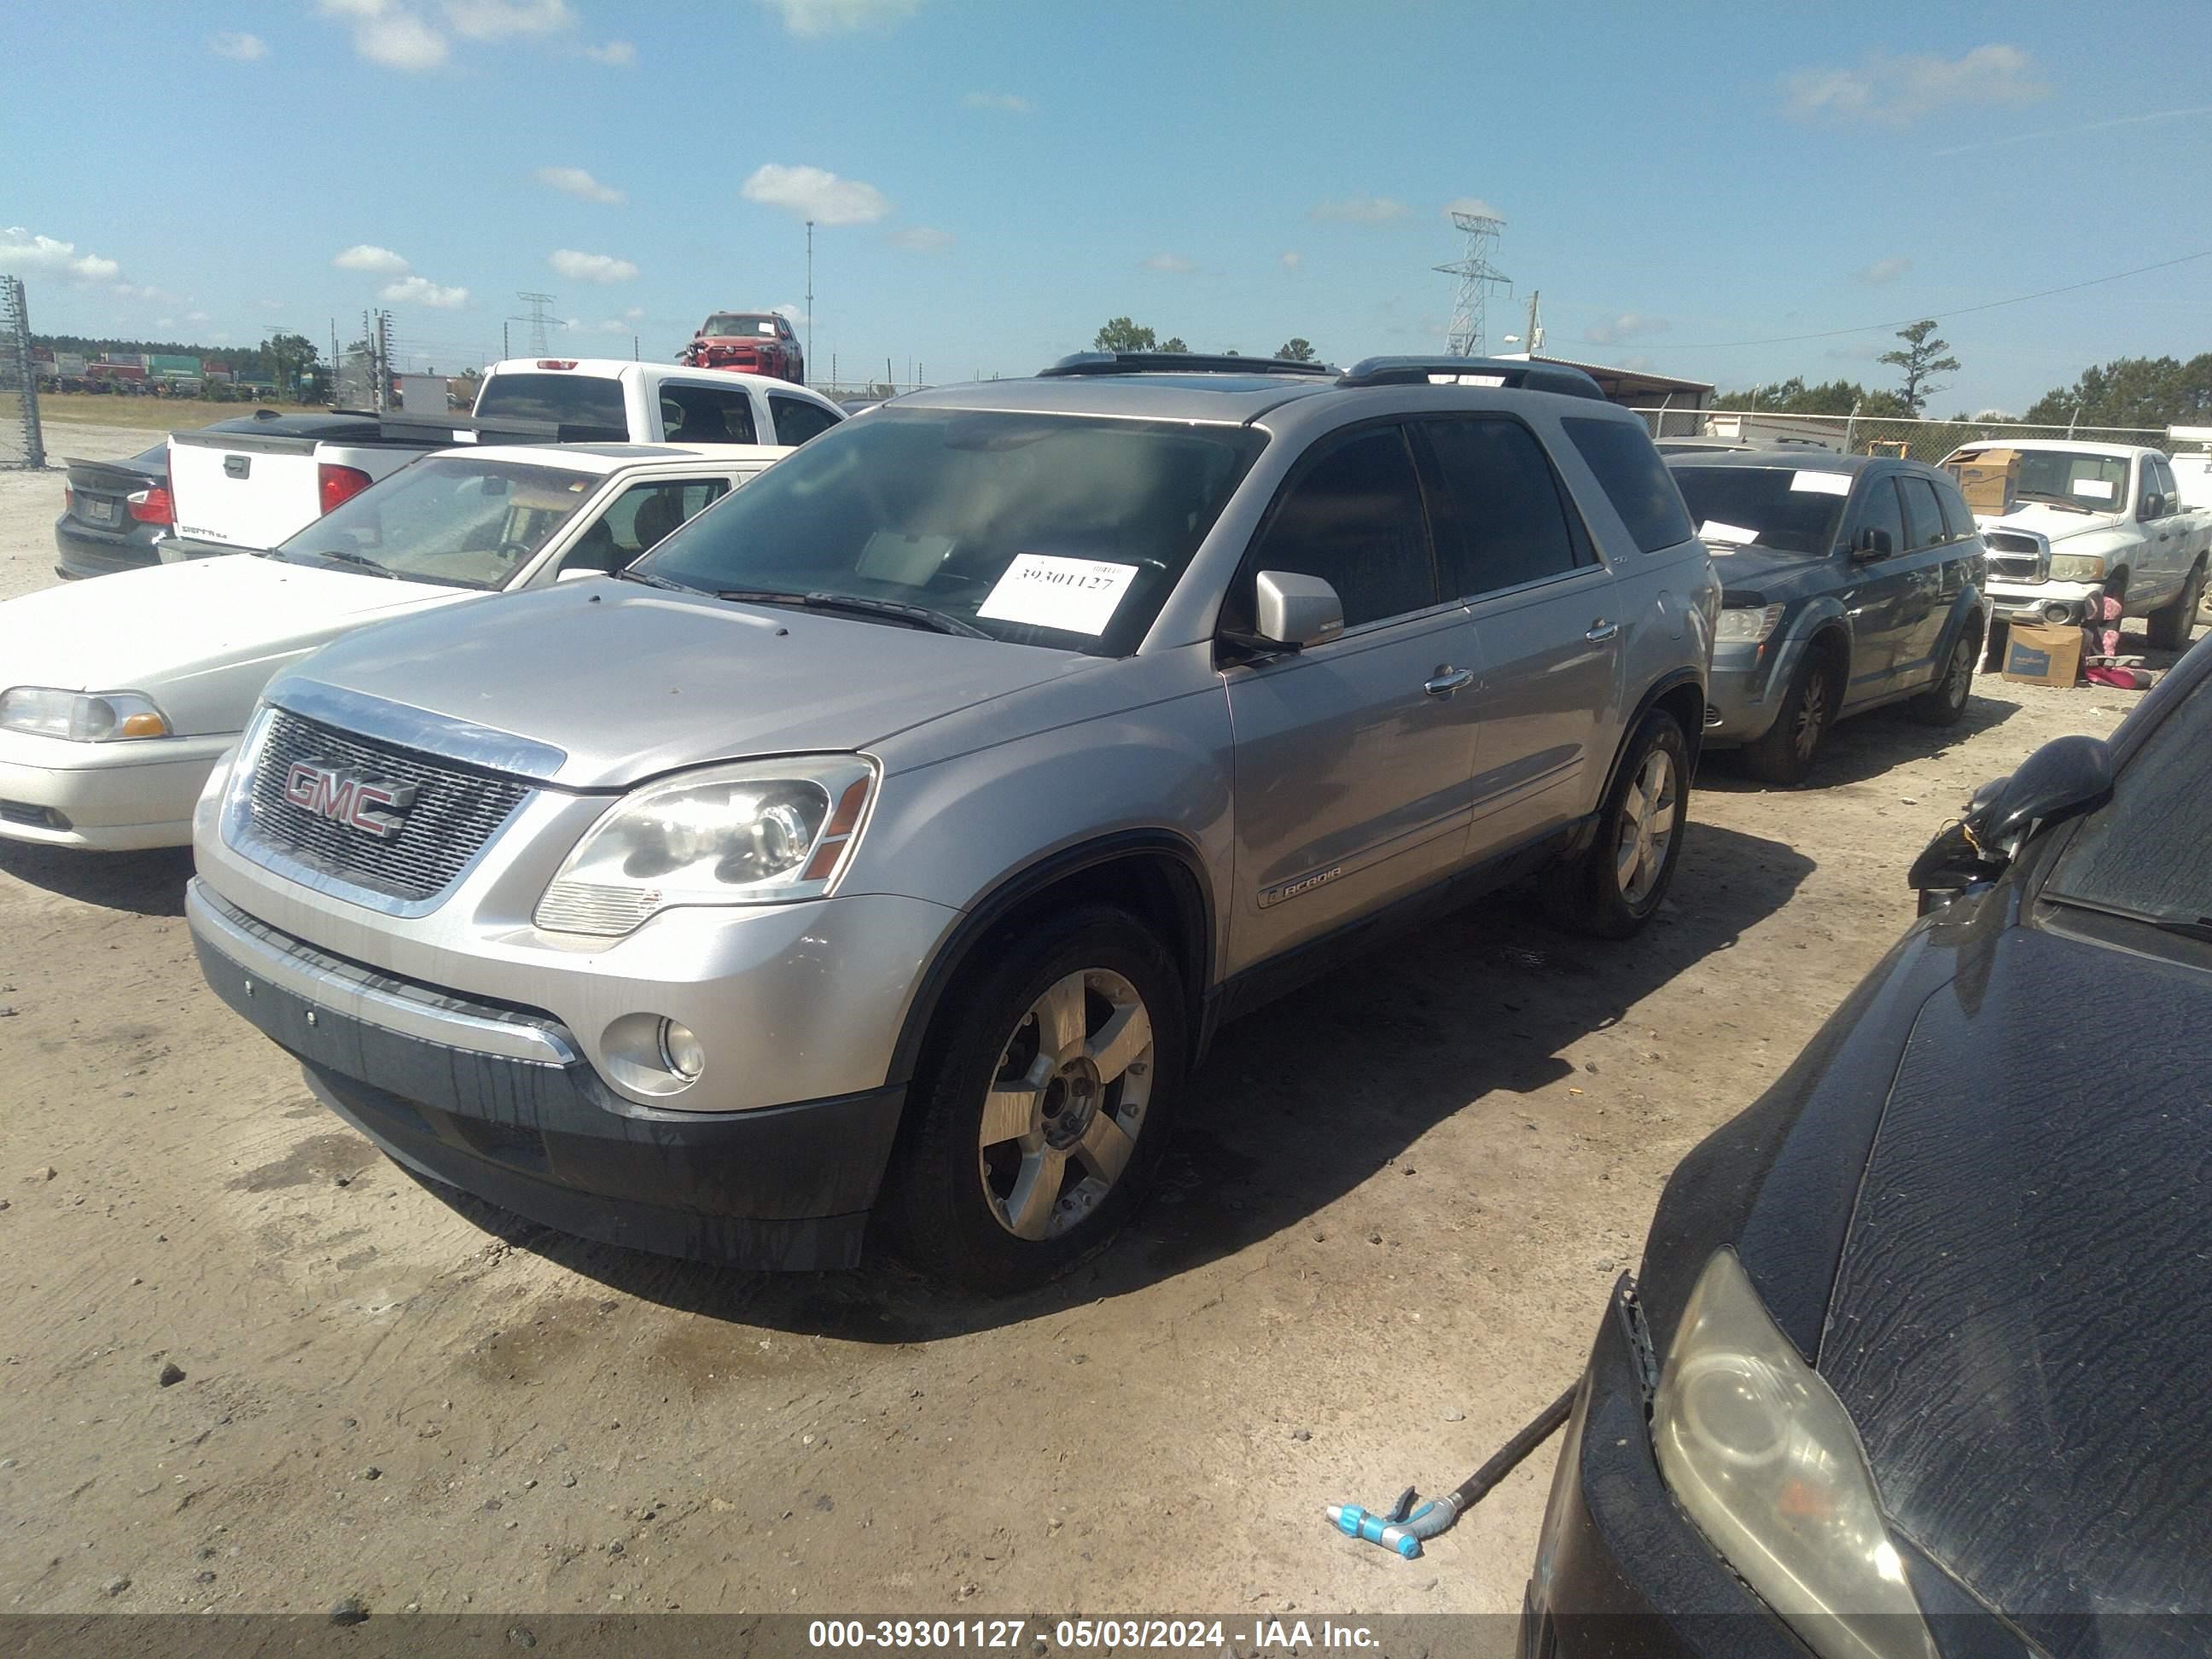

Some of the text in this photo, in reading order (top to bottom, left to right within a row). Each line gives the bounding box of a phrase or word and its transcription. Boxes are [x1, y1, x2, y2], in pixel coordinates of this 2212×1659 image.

[1016, 568, 1115, 591] 39301127
[284, 761, 398, 838] GMC
[1284, 867, 1342, 896] ACADIA
